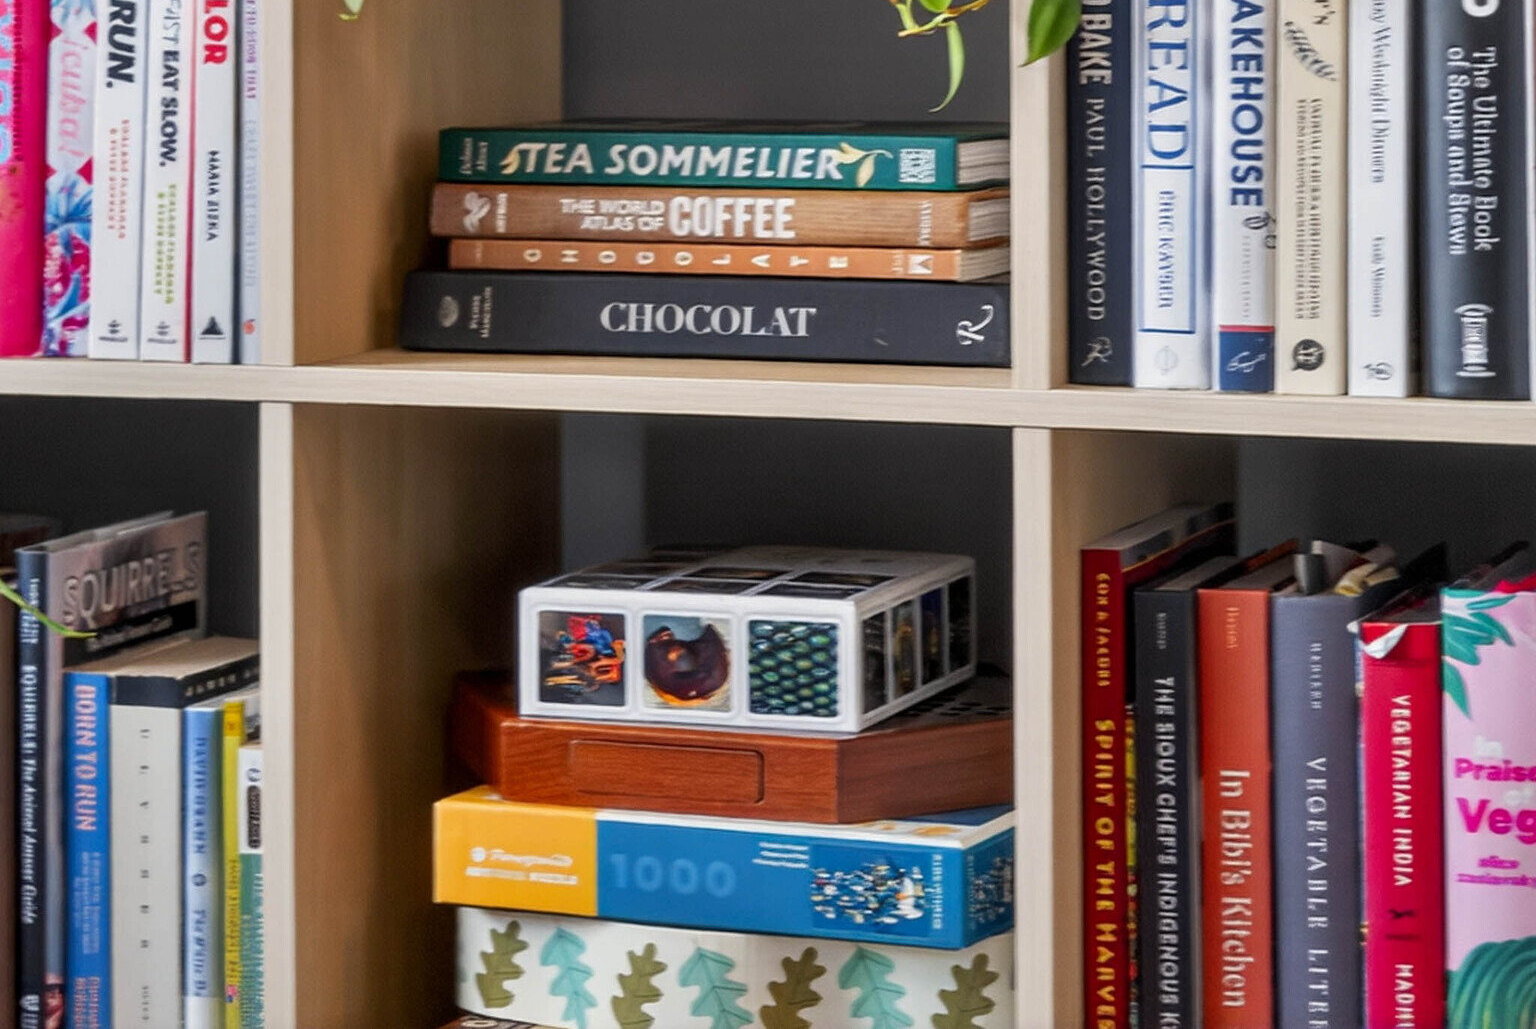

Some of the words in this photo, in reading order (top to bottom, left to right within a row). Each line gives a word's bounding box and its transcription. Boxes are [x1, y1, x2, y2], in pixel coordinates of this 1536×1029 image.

[163, 50, 180, 91] EAT
[1079, 13, 1113, 85] BAKE
[1446, 47, 1471, 68] of
[1472, 46, 1498, 88] The
[1086, 97, 1106, 157] PAUL
[1442, 75, 1470, 140] Soups
[514, 142, 595, 174] TEA
[604, 144, 844, 180] SOMMELIER
[1448, 146, 1472, 186] and
[1472, 95, 1498, 188] Ultimate
[559, 198, 596, 214] THE
[599, 199, 666, 216] WORLD
[580, 215, 635, 231] ATLAS
[637, 216, 665, 231] OF
[669, 195, 796, 239] COFFEE
[1473, 195, 1500, 251] Book
[1085, 166, 1107, 320] HOLLYWOOD
[600, 301, 817, 337] CHOCOLAT
[64, 541, 202, 628] SQUIRRELS
[74, 685, 98, 746] BORN
[1154, 677, 1176, 715] THE
[75, 751, 97, 779] TO
[1094, 719, 1116, 807] SPIRIT
[1154, 723, 1176, 786] SIOUX
[1391, 695, 1413, 819] VEGETARIAN
[74, 784, 97, 830] RUN
[1219, 770, 1251, 798] In
[1095, 817, 1115, 850] OF
[1155, 793, 1178, 865] CHEF'S
[1221, 809, 1253, 885] Bibi's
[1305, 757, 1327, 928] VEGETABLE
[1392, 828, 1413, 886] INDIA
[610, 853, 736, 898] 1000
[1095, 861, 1115, 911] THE
[1157, 873, 1179, 1004] INDIGENOUS
[1221, 897, 1256, 1008] Kitchen
